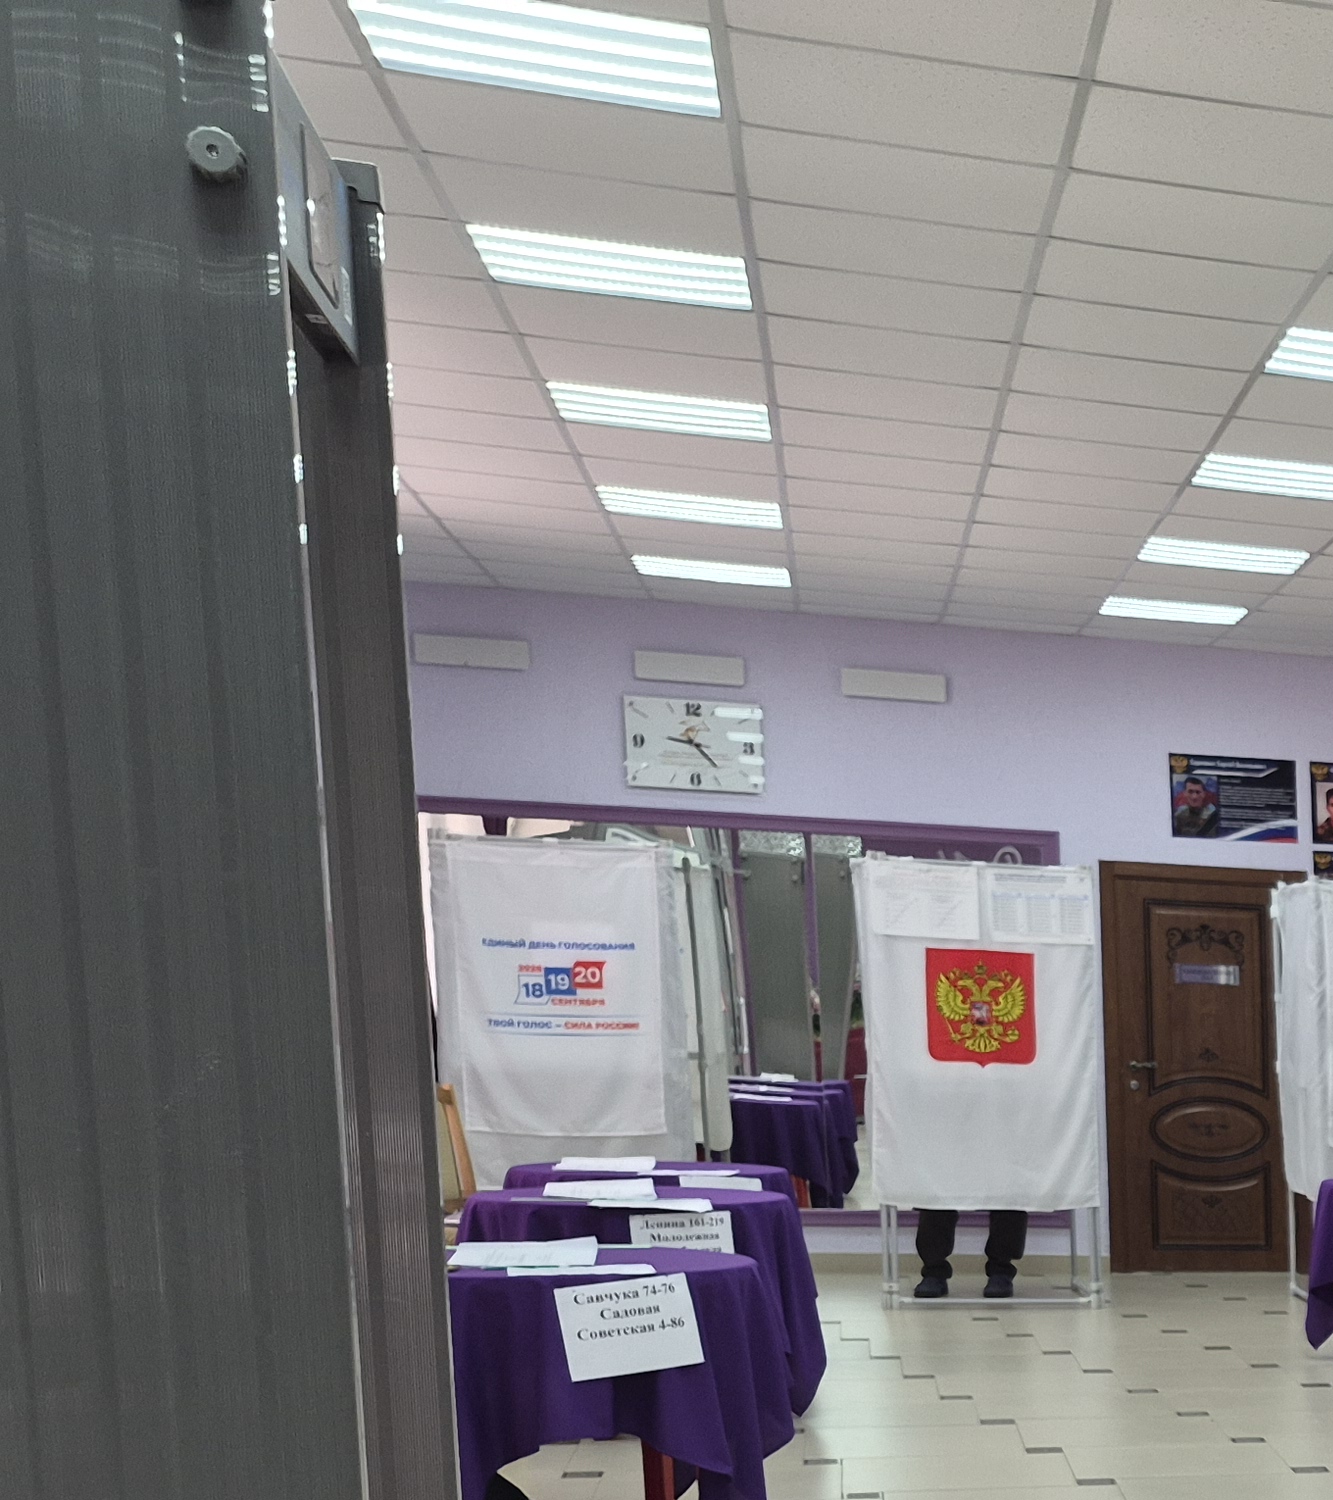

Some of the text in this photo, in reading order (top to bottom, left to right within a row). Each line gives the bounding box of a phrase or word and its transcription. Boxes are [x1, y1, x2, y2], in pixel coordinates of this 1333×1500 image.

[685, 702, 702, 717] 12
[522, 967, 601, 998] 18 19 20
[573, 1282, 676, 1305] Савчука 74-76
[600, 1304, 661, 1320] Садовая
[576, 1316, 686, 1341] Советская 4-86
